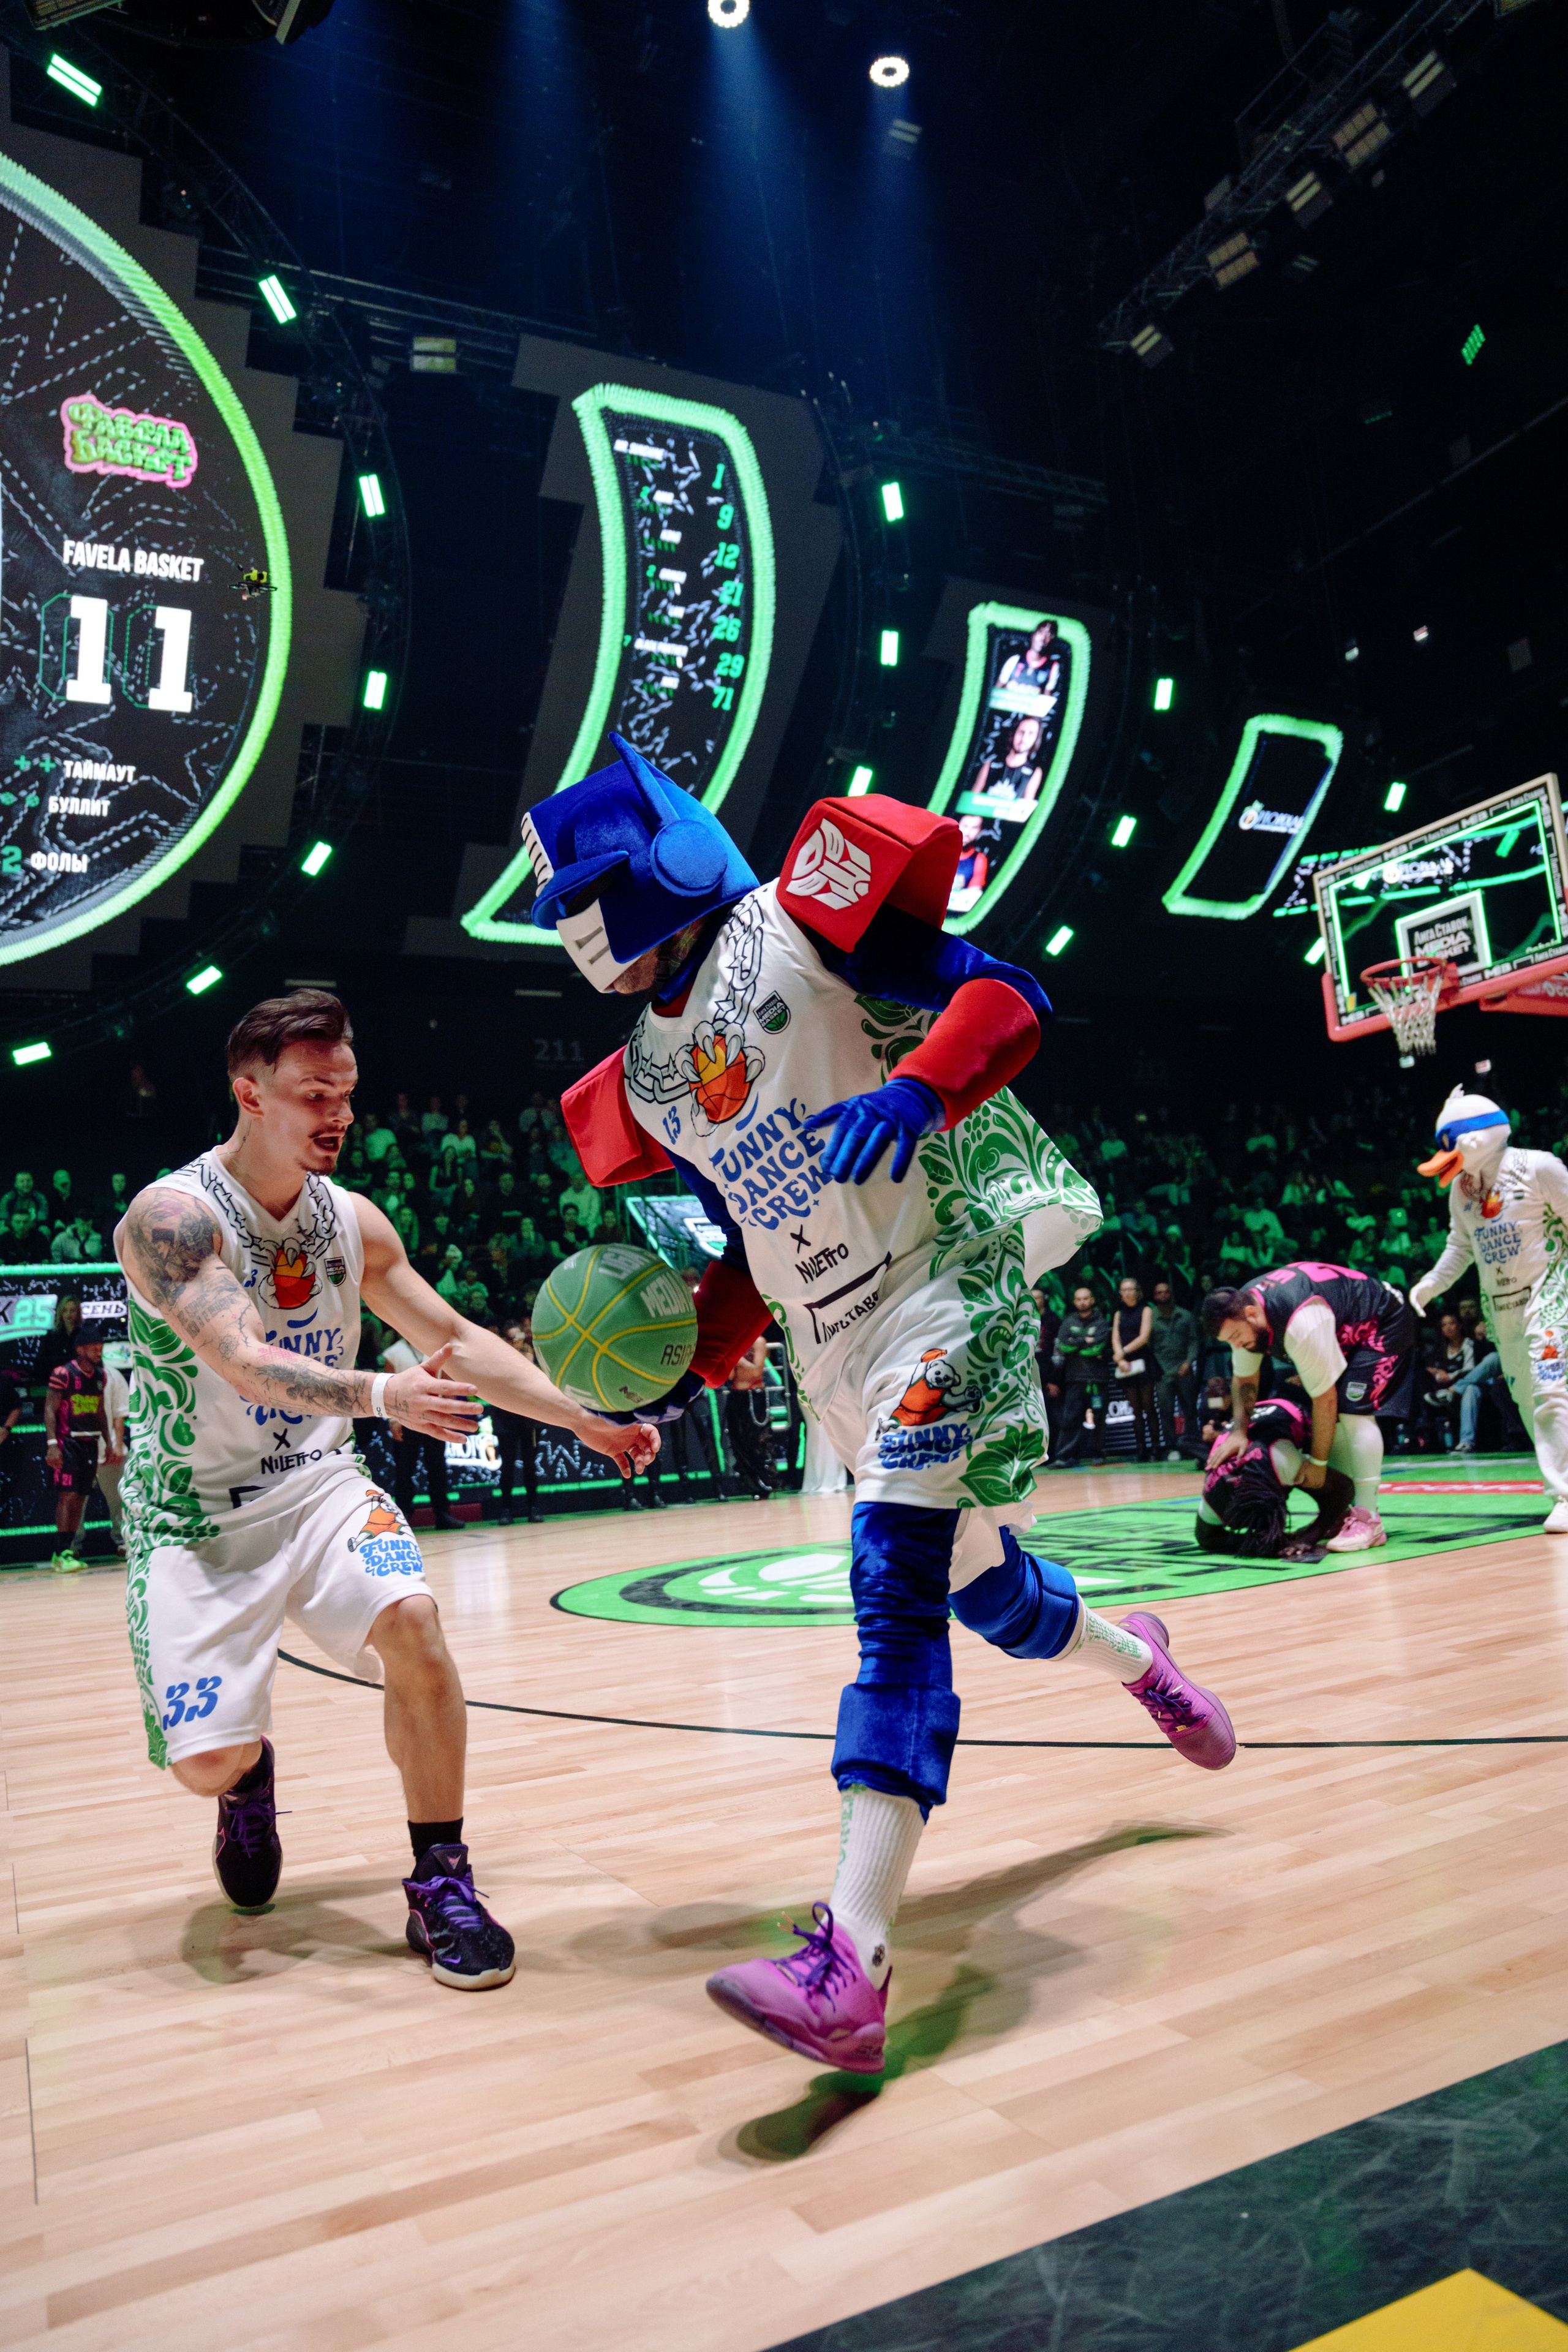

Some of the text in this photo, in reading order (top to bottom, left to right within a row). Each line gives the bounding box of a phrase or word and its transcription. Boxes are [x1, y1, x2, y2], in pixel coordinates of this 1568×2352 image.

[712, 464, 725, 489] 1
[717, 504, 734, 530] 9
[63, 540, 205, 582] FAVELA BASKET
[714, 542, 740, 568] 12
[718, 581, 744, 606] 21
[714, 617, 741, 641] 26
[66, 595, 192, 712] 11
[716, 652, 744, 677] 29
[712, 687, 734, 710] 71
[63, 759, 136, 782] ТАЙМАУТ
[48, 796, 111, 816] БУЛЛИТ
[1, 846, 88, 873] 2 ФОЛЫ
[1415, 931, 1470, 957] MEDIA
[759, 1002, 785, 1023] MEDIA
[663, 1106, 680, 1145] 13
[81, 1304, 123, 1316] СЕНЬ
[882, 1423, 968, 1444] FUNNY
[261, 1449, 322, 1475] NILETTO
[375, 1561, 423, 1577] CREW
[163, 1676, 222, 1731] 33
